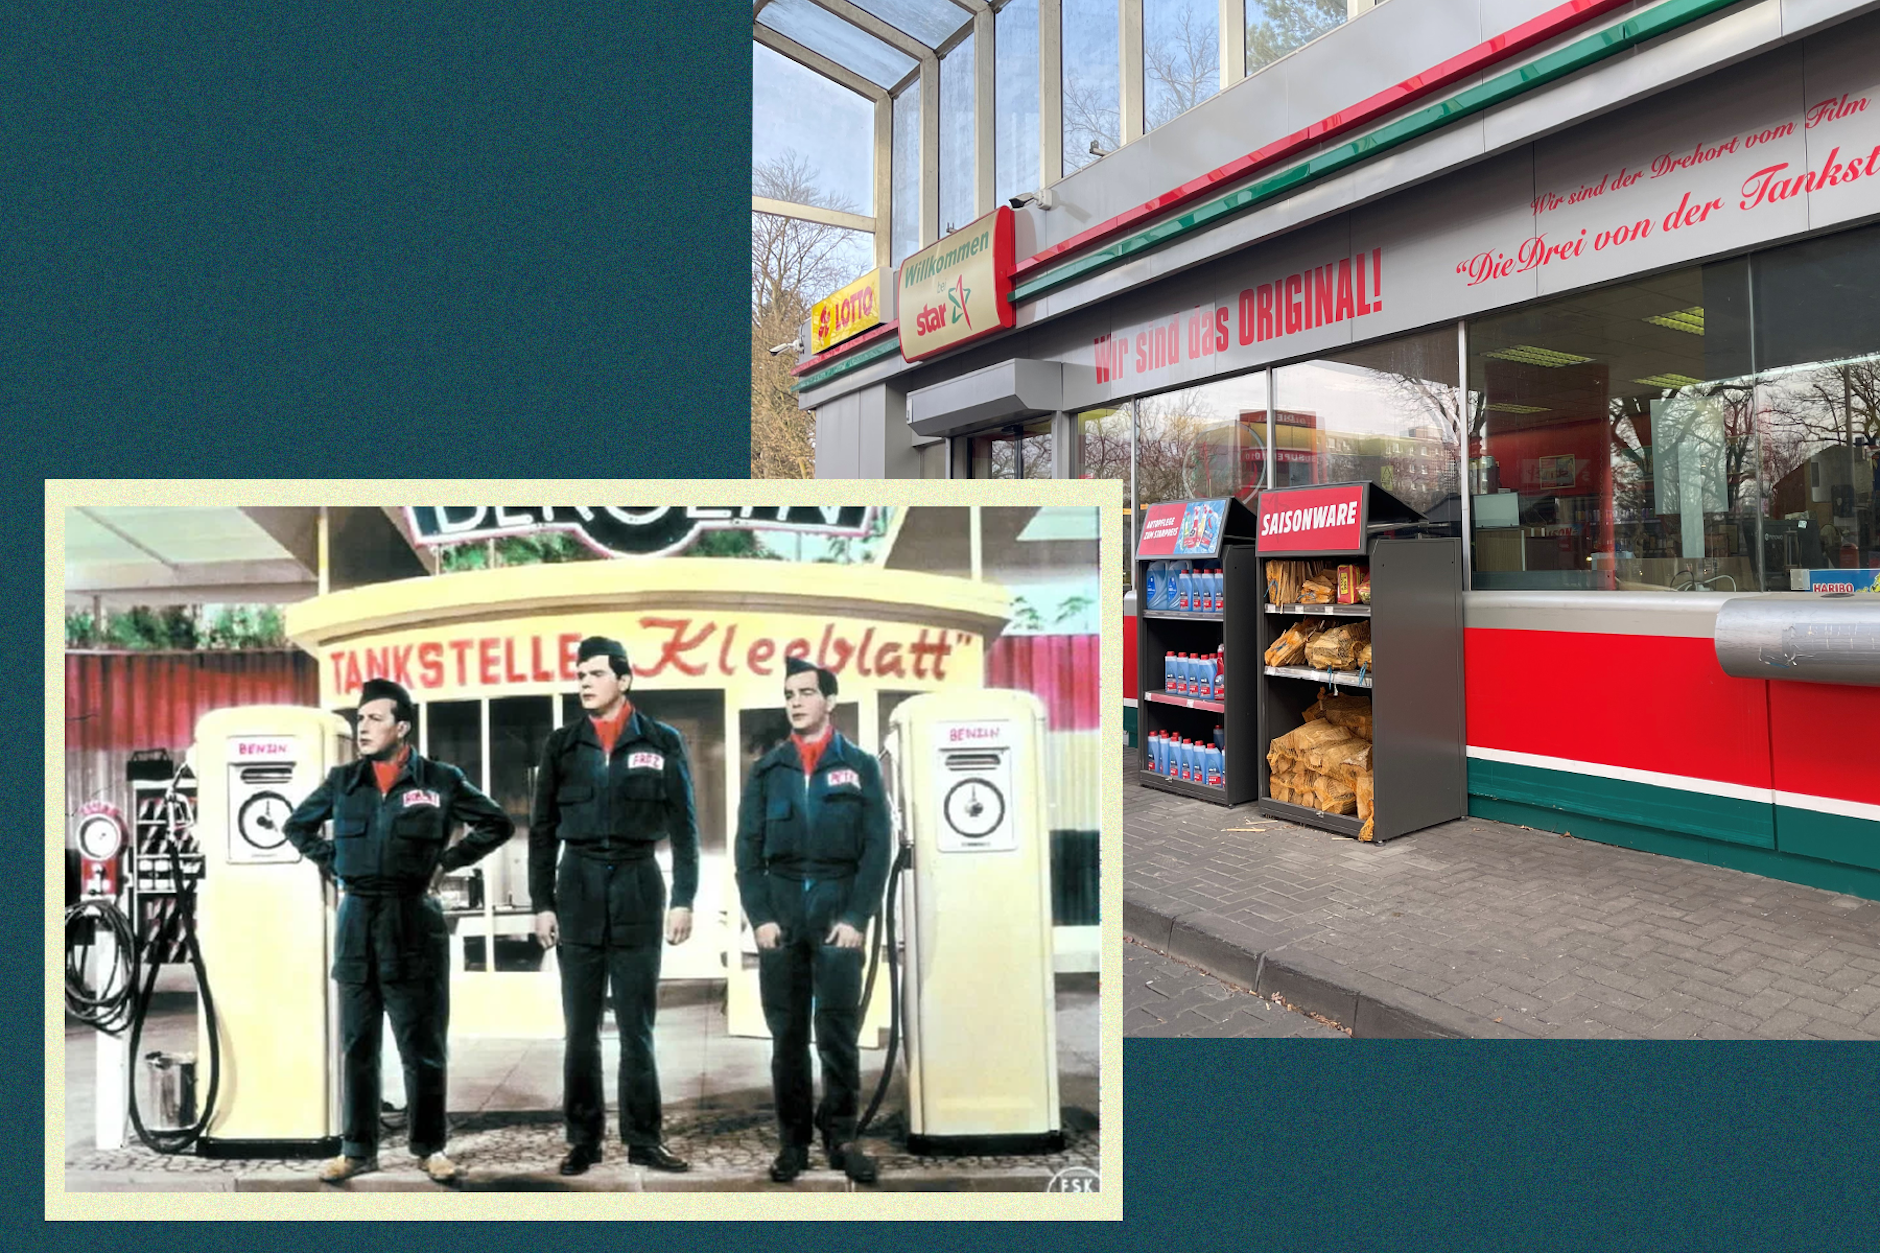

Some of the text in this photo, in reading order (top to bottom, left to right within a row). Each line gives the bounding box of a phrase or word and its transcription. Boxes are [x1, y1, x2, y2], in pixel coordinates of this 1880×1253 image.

[1530, 93, 1871, 217] Wir sind der Drehort vom Film
[1593, 215, 1656, 250] von
[1662, 191, 1726, 232] der
[905, 231, 989, 289] Willkommen
[835, 286, 873, 331] LOTTO
[916, 303, 947, 336] star
[1094, 247, 1383, 384] Wir sind das ORIGINAL!
[1261, 500, 1358, 537] SAISONWARE
[1813, 583, 1854, 593] HARIBO
[330, 633, 583, 696] TANKSTELLE
